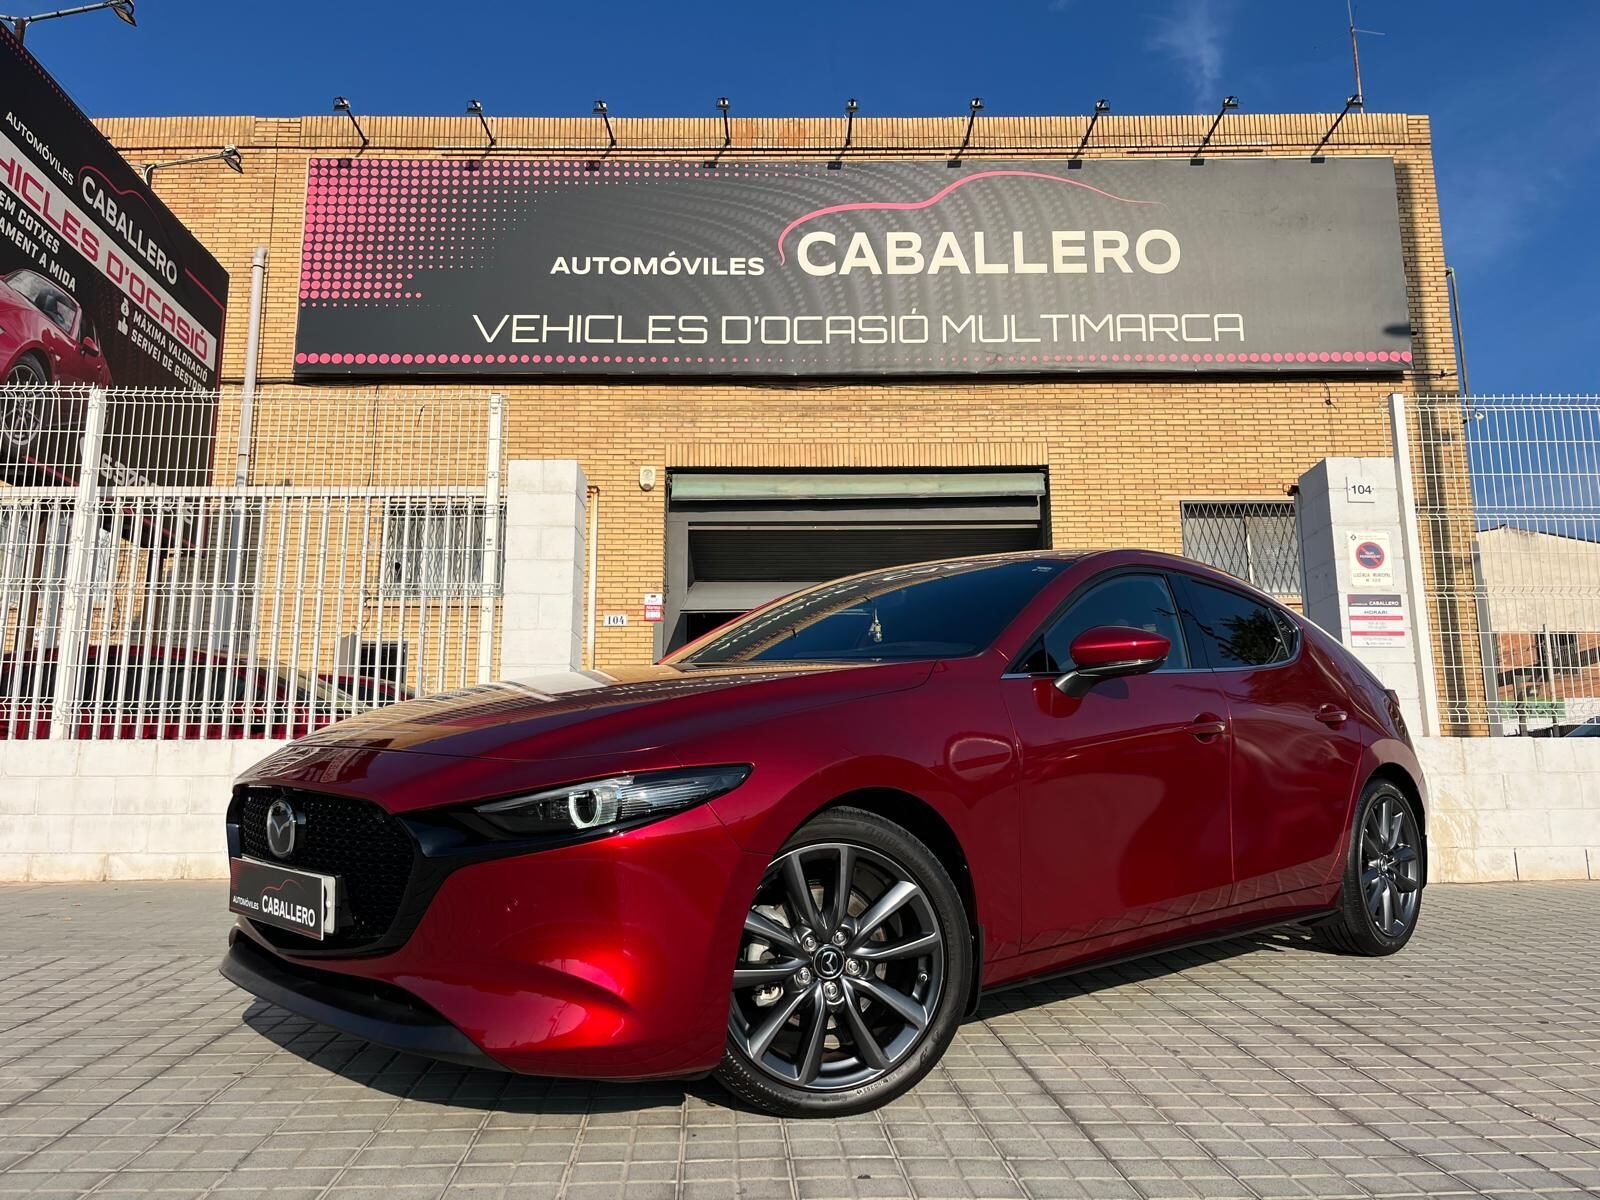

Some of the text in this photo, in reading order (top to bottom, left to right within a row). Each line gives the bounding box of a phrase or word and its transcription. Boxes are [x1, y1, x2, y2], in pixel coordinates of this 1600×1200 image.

[5, 111, 178, 286] AUTOMÓVILES CABALLERO
[17, 208, 60, 254] COTXES
[38, 252, 48, 269] A
[49, 259, 76, 292] MIDA
[550, 229, 1182, 278] AUTOMÓVILES CABALLERO
[106, 250, 208, 361] D'OCASIÓ
[472, 308, 1247, 345] VEHICLES D'OCASIÓ MULTIMARCA
[131, 329, 209, 401] SERVEI DE GESTOR
[168, 340, 208, 382] VALORACIÓ
[1351, 484, 1372, 495] 104
[607, 615, 625, 625] 104
[262, 895, 316, 927] CABALLERO
